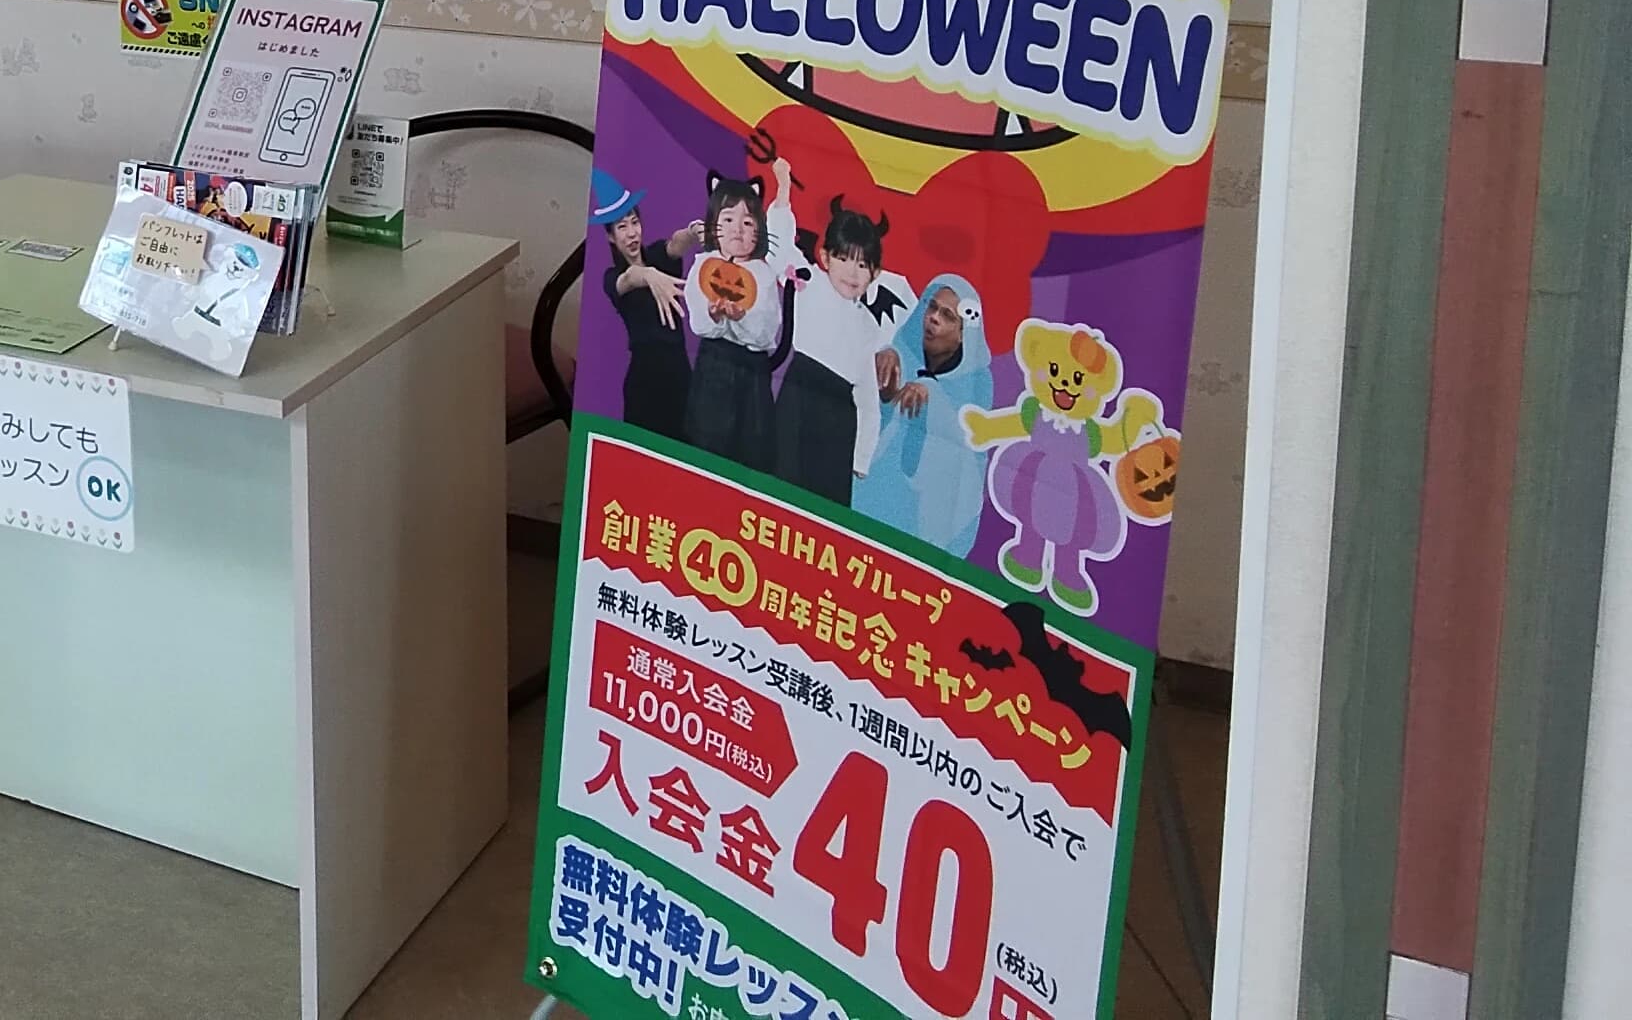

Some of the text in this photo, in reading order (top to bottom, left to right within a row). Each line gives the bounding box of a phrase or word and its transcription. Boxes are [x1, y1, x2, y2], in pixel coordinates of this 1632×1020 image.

[236, 7, 363, 39] INSTAGRAM
[257, 41, 320, 59] はじめました
[140, 236, 179, 257] ご自由に
[141, 219, 204, 245] パンフレットは
[87, 474, 122, 503] OK
[739, 510, 952, 624] SEIHA グループ
[626, 644, 757, 731] 通常入会金
[584, 730, 783, 898] 入会金
[560, 843, 838, 1020] 無料体験レッス
[996, 942, 1058, 1005] (税込)
